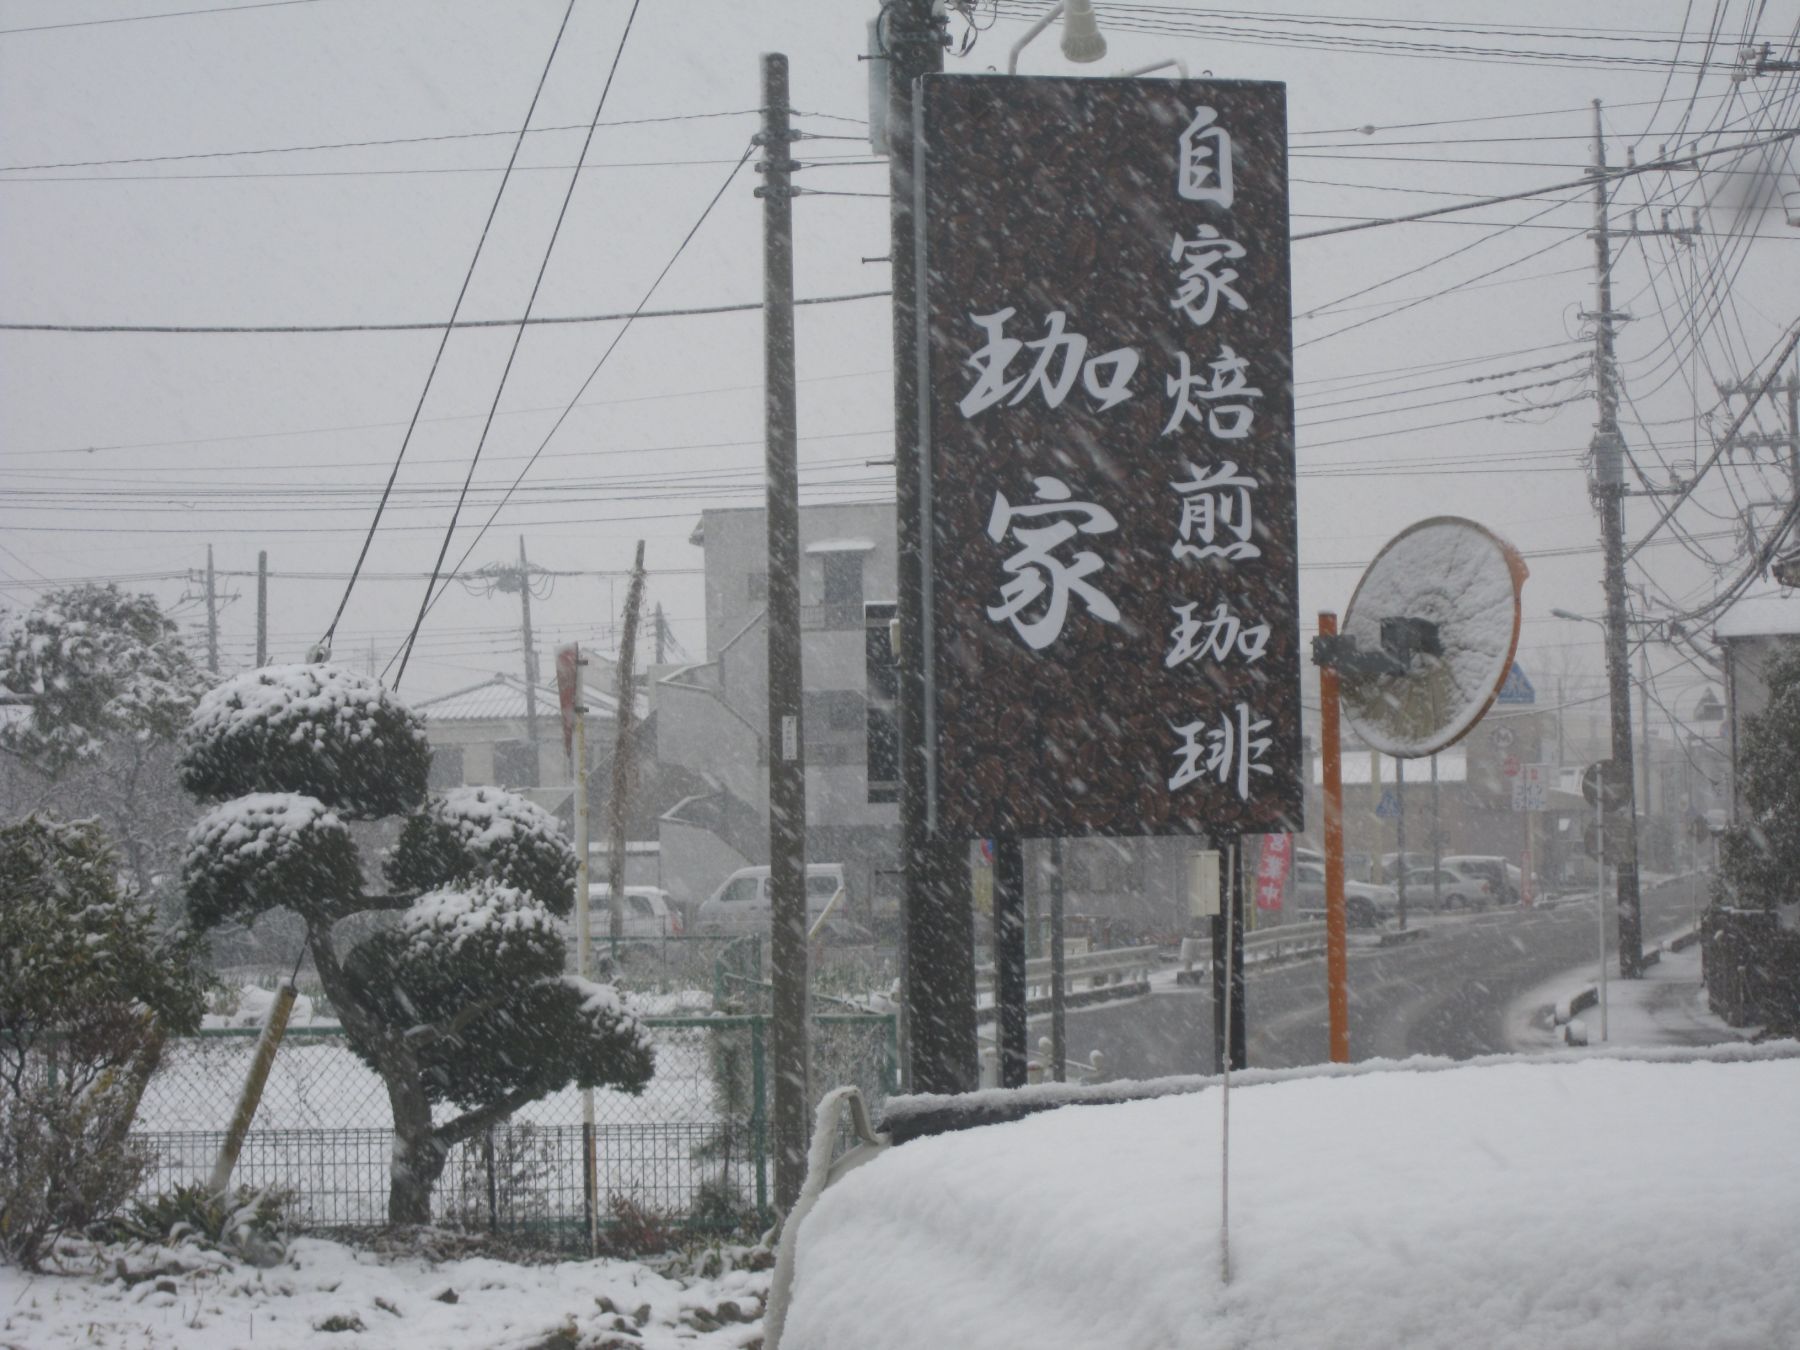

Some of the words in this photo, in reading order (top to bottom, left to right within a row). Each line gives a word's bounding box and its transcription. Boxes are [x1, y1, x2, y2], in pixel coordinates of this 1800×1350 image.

[958, 306, 1140, 650] 珈家
[1161, 105, 1274, 800] 自家焙煎珈琲
